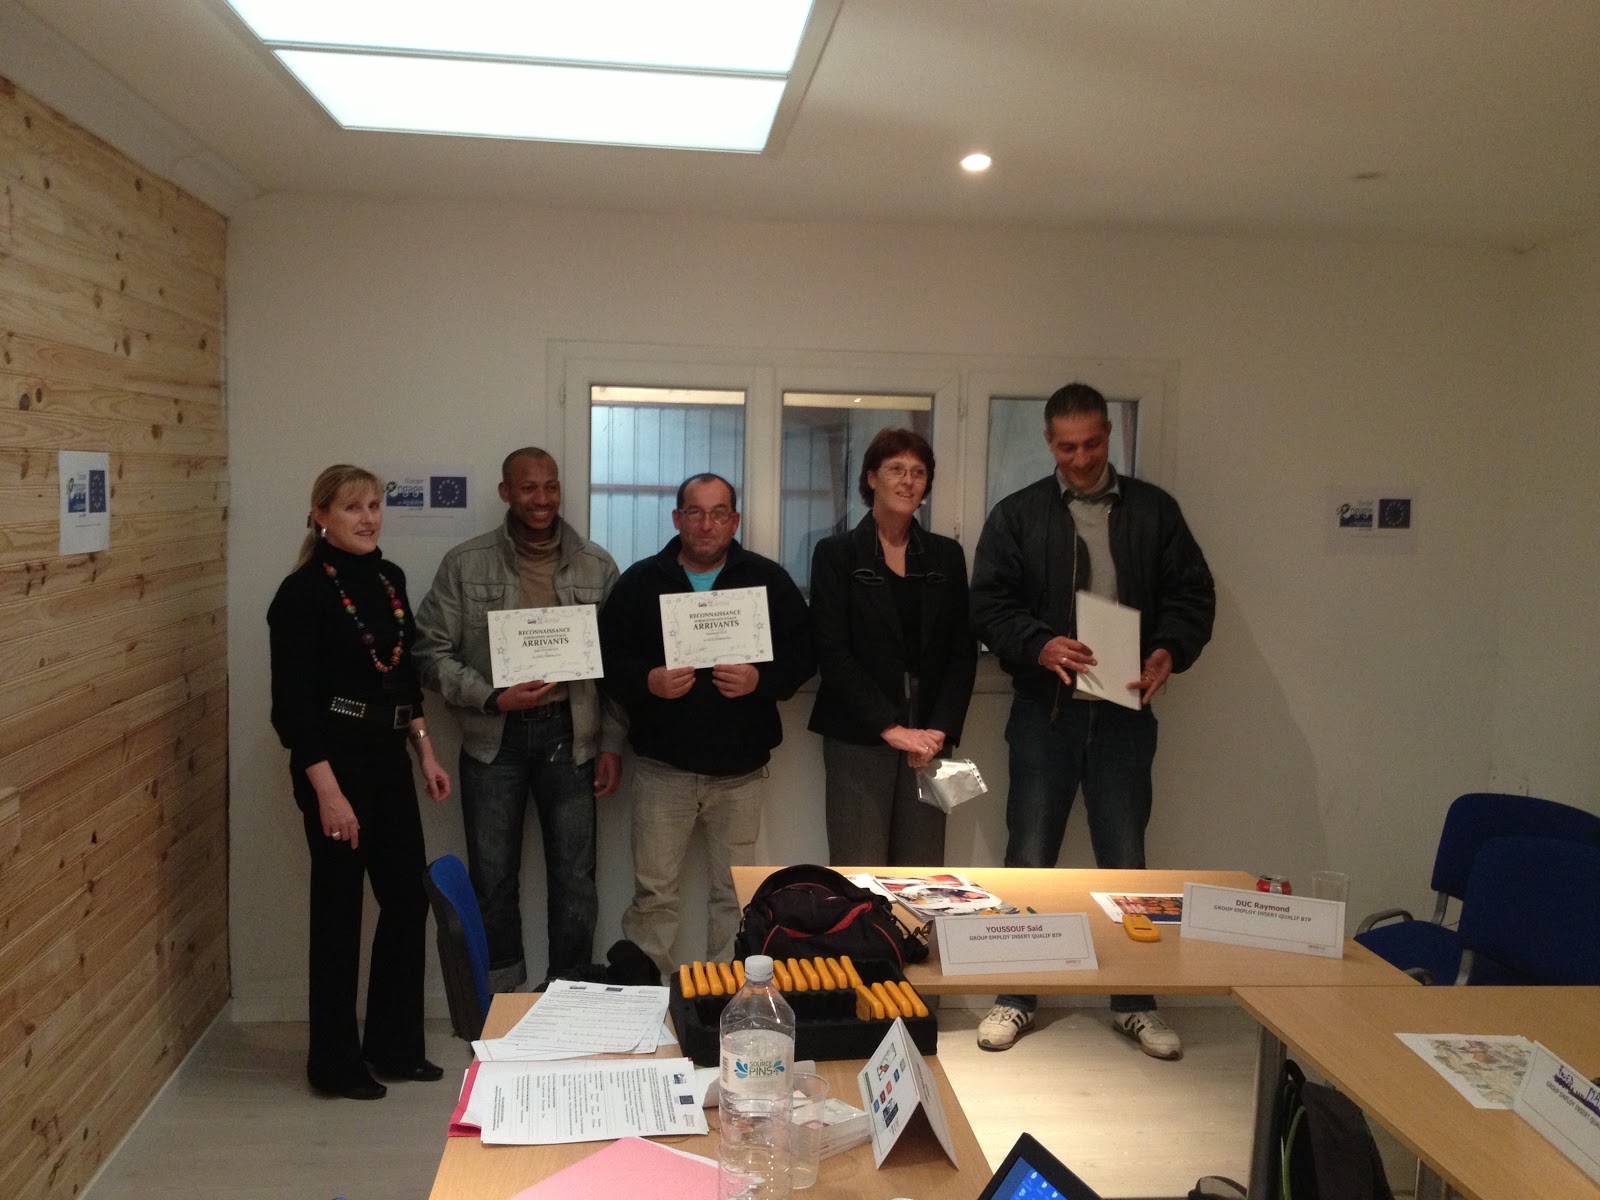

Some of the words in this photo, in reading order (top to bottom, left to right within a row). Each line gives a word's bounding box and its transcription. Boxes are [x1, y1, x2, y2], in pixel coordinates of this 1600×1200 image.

[689, 609, 741, 619] RECONNAISSANCE
[693, 620, 740, 630] ARRIVANTS
[518, 627, 571, 636] RECONNAISSANCE
[522, 637, 569, 648] ARRIVANTS
[1213, 904, 1233, 912] GROUP
[1233, 907, 1256, 915] EMPLOY
[1257, 910, 1278, 918] INSERT
[1235, 899, 1253, 908] DUC
[1254, 901, 1290, 913] Raymond
[985, 925, 1025, 934] YOUSSOUF
[749, 1060, 773, 1068] SOURCE
[749, 1066, 773, 1076] PINS
